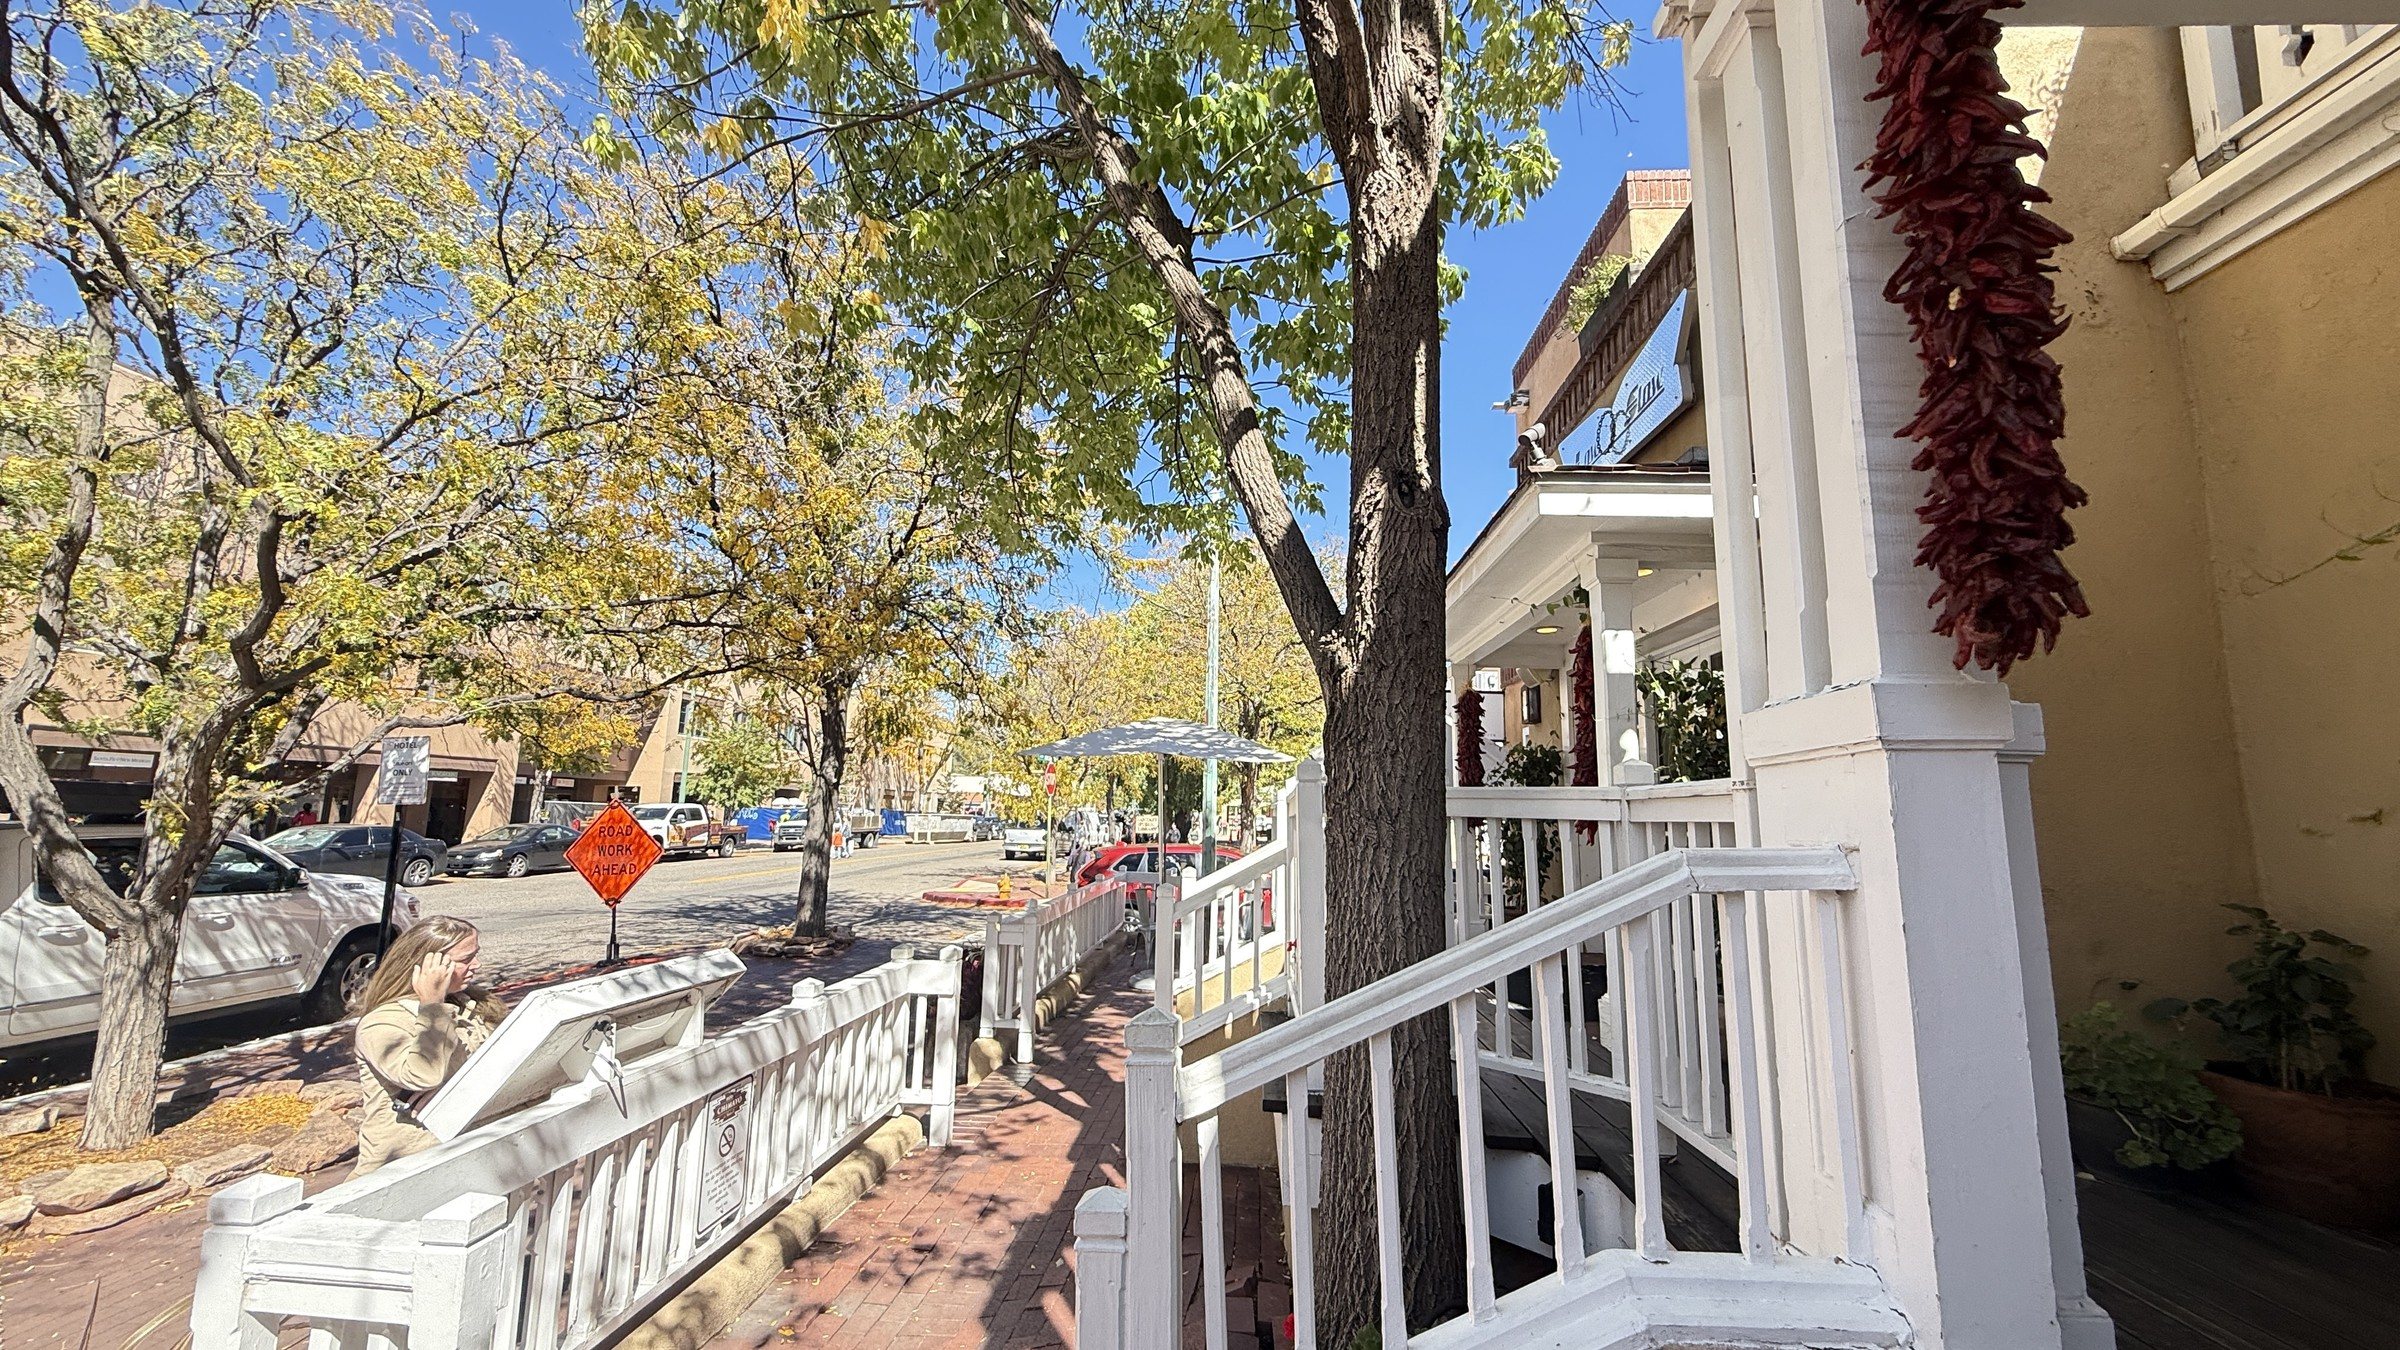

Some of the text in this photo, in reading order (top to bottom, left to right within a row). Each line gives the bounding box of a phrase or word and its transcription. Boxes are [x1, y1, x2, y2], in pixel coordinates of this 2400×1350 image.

[394, 741, 417, 749] HOTEL
[392, 768, 413, 777] ONLY
[598, 824, 633, 838] ROAD
[597, 844, 633, 857] WORK
[592, 863, 637, 876] AHEAD
